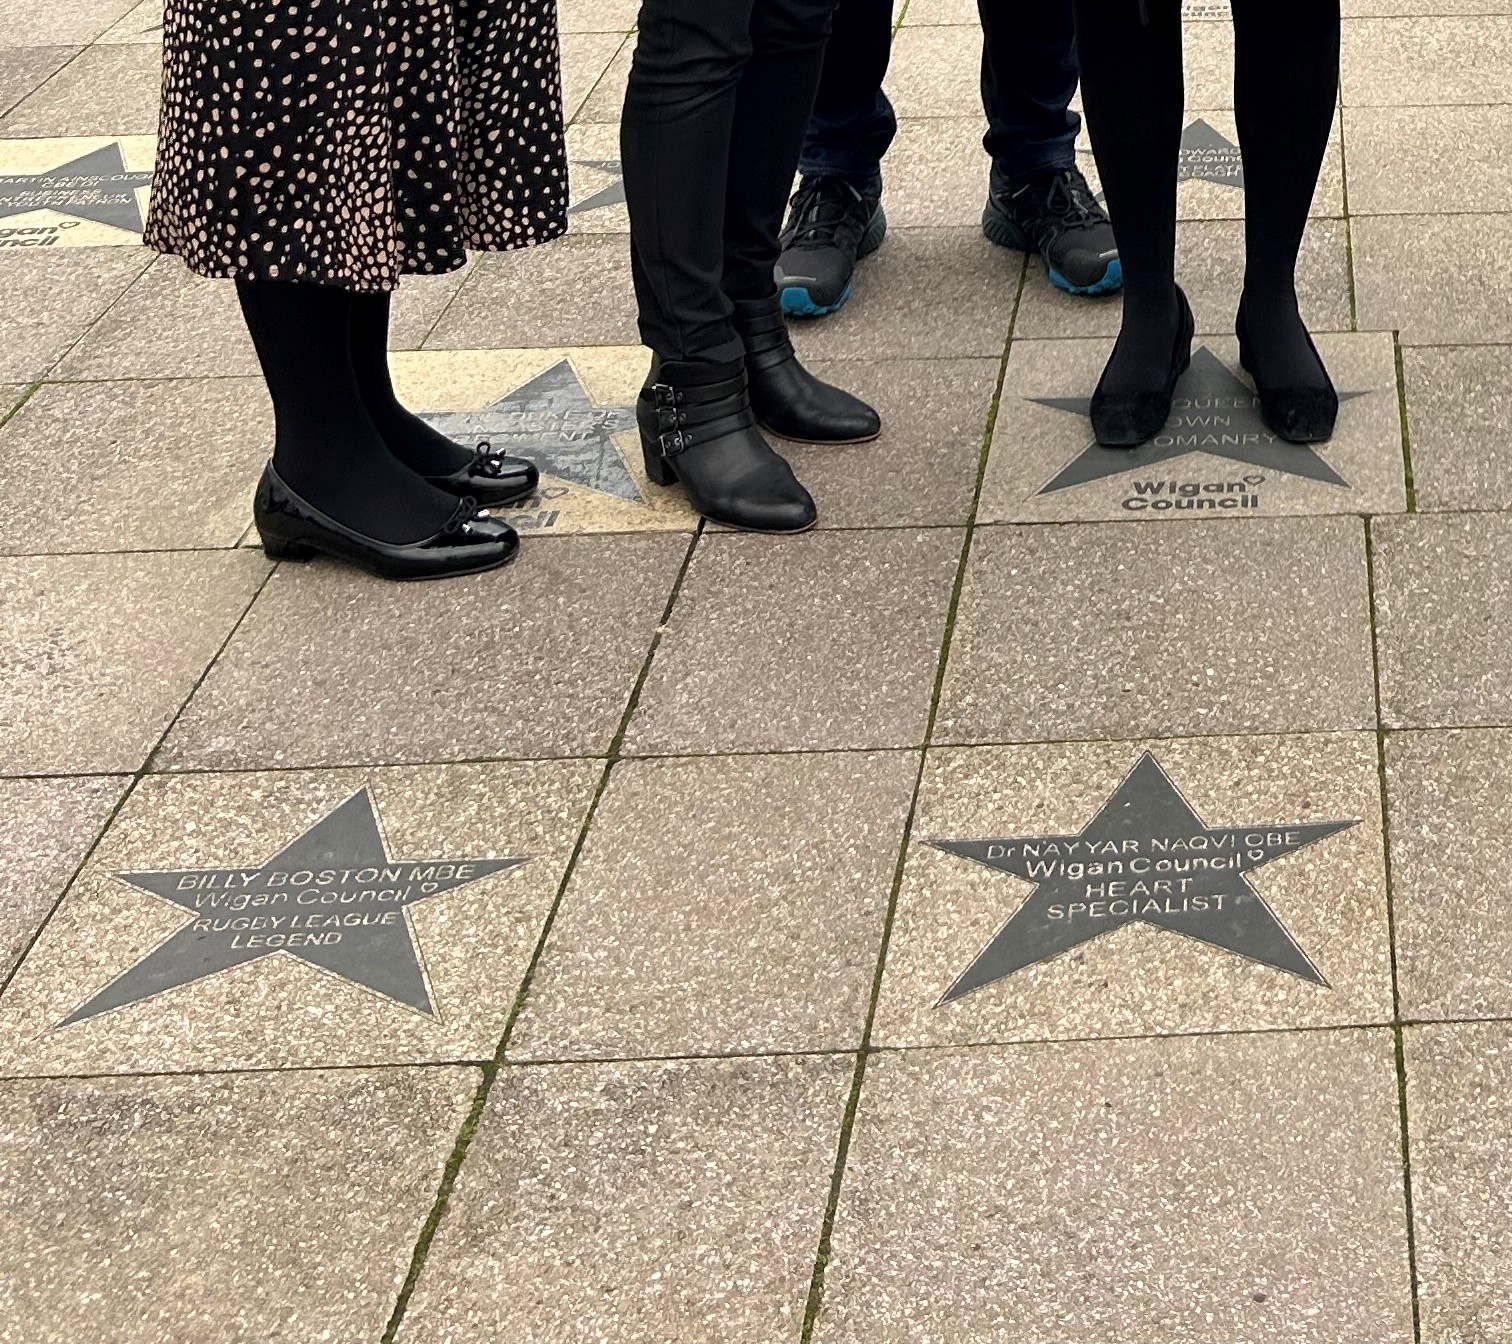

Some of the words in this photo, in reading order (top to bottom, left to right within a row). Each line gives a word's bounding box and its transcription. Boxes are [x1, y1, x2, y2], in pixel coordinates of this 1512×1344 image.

[0, 225, 58, 238] gan
[1165, 415, 1231, 428] OWN
[1153, 433, 1278, 448] OMANRY
[1132, 481, 1247, 497] Wigan
[1121, 494, 1259, 511] Council
[1021, 838, 1140, 857] NAYYAR
[1150, 833, 1237, 853] NAQVI
[1243, 829, 1301, 848] OBE
[1024, 856, 1124, 880] Wigan
[1128, 850, 1243, 872] Council
[175, 868, 264, 891] BILLY
[265, 866, 403, 888] BOSTON
[408, 862, 476, 883] MBE
[195, 889, 290, 910] Wigan
[296, 885, 411, 907] Council
[1085, 877, 1195, 898] HEART
[1046, 893, 1228, 921] SPECIALIST
[191, 913, 286, 934] RUGBY
[285, 910, 397, 931] LEAGUE
[230, 931, 343, 950] LEGEND
